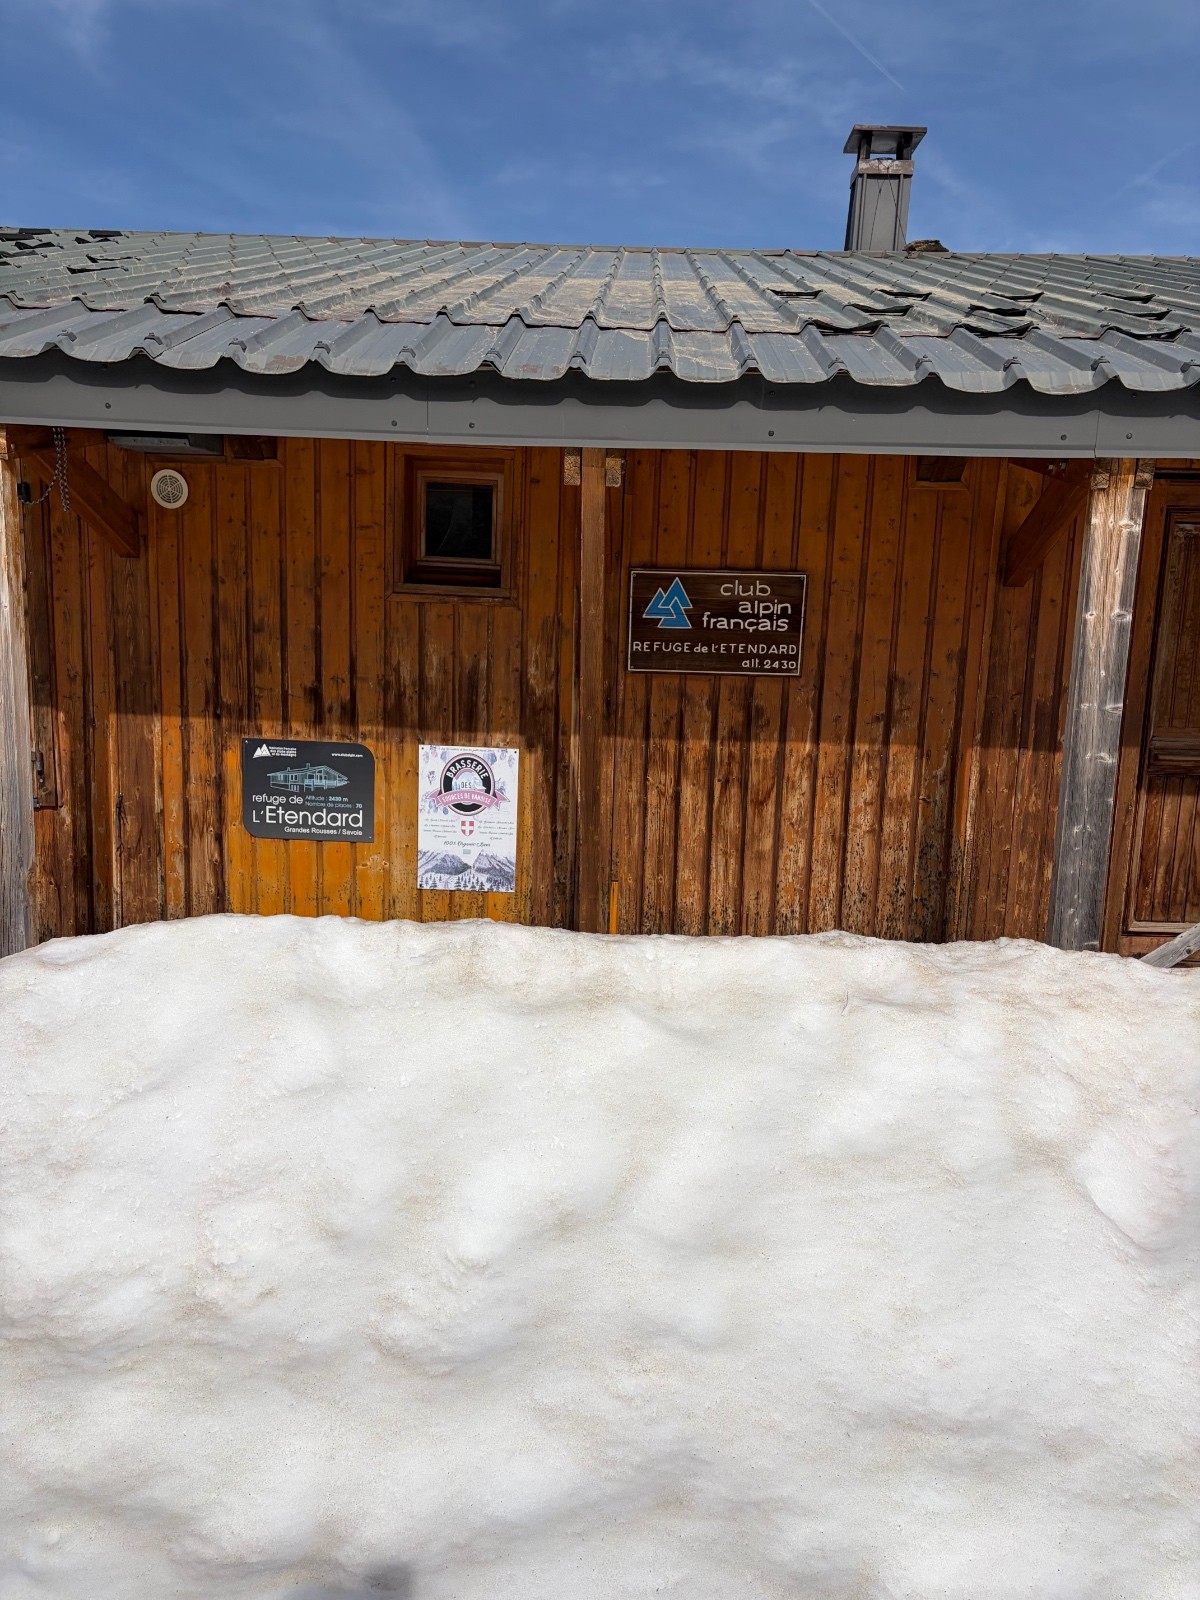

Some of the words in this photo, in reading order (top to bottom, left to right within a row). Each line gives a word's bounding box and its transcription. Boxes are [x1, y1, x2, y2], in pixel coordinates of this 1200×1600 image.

[720, 580, 771, 596] club
[738, 600, 792, 617] alpin
[702, 612, 789, 632] français
[632, 641, 691, 652] REFUGE
[693, 643, 708, 653] de
[763, 659, 797, 669] 2430
[446, 759, 489, 779] BRASSERIE
[252, 793, 286, 805] refuge
[289, 795, 304, 804] de
[284, 826, 310, 834] Grandes
[311, 827, 338, 835] Rousses
[342, 828, 363, 836] Savoie
